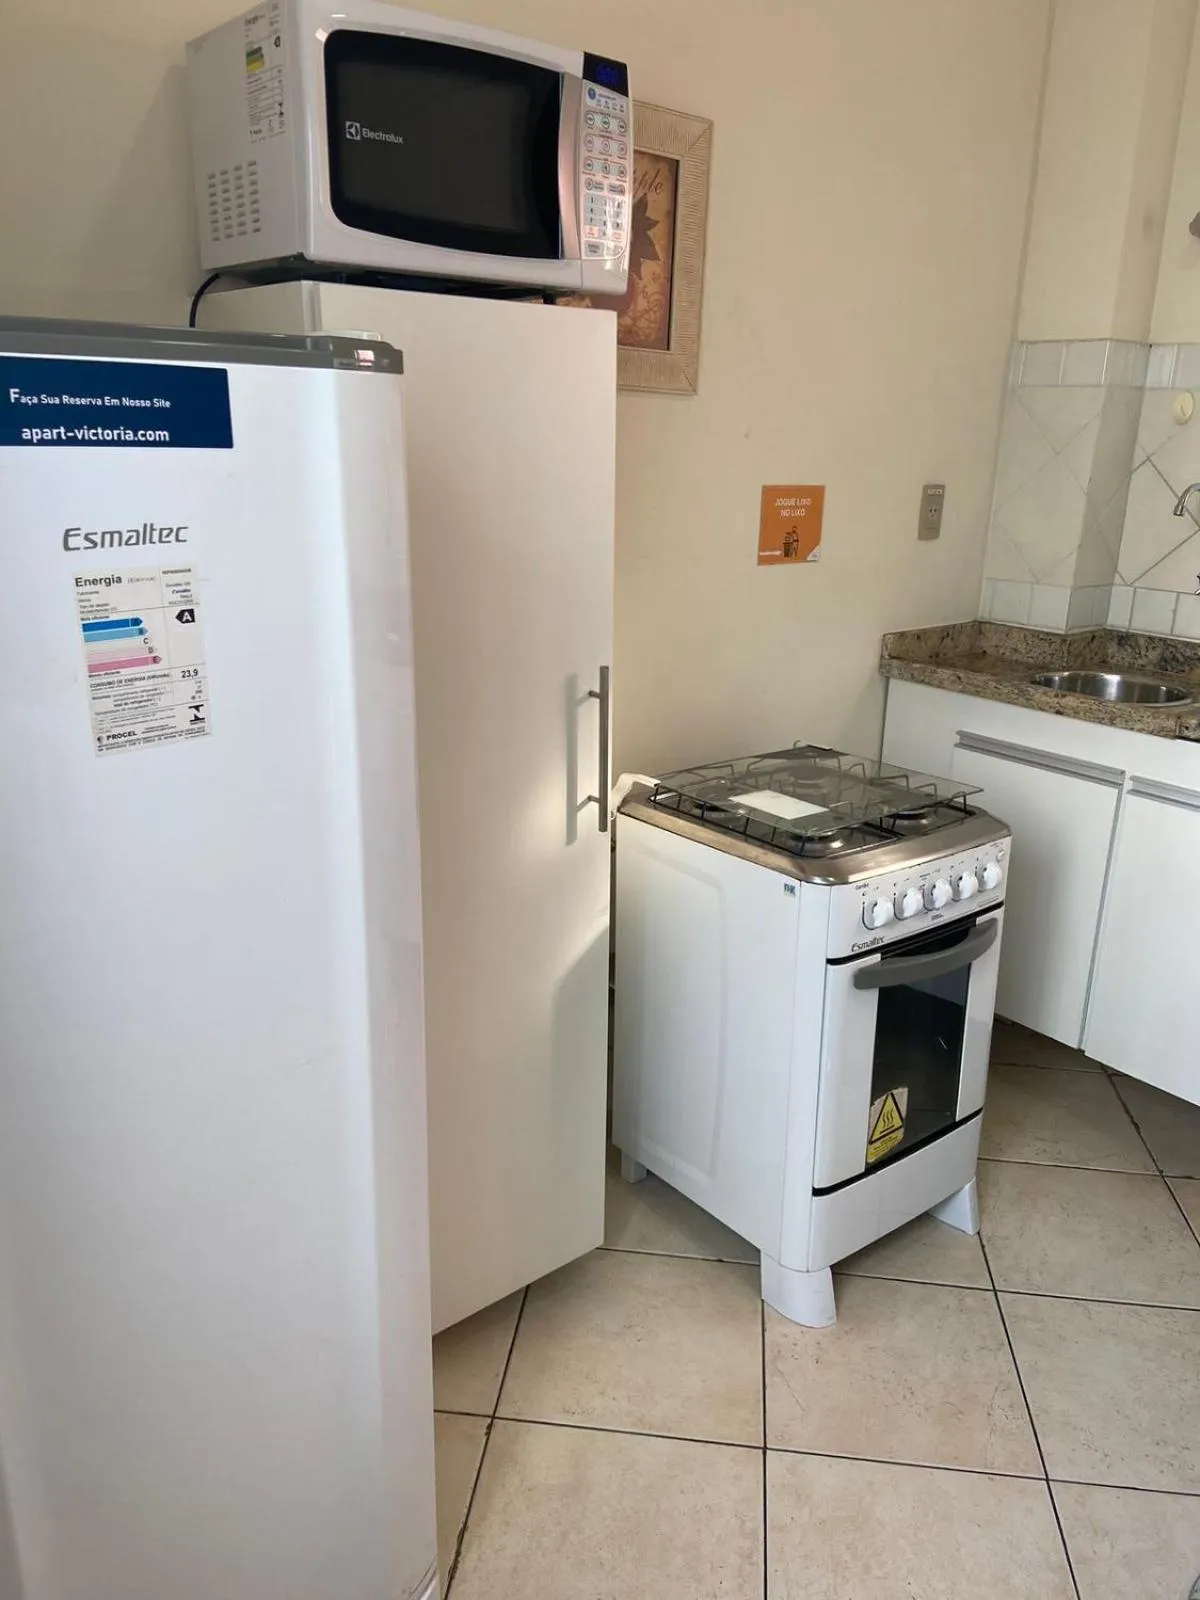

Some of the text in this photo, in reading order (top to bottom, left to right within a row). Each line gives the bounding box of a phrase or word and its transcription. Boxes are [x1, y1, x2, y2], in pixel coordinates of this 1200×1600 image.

[361, 128, 404, 144] Electrolux
[9, 388, 171, 408] Faça Sua Reserva Em Nosso Site
[21, 425, 170, 443] apart-victoria.com
[62, 522, 189, 551] Esmaltec
[74, 574, 123, 588] Energia
[182, 611, 192, 622] A
[180, 668, 199, 679] 23,9
[106, 731, 138, 741] PROCEL
[851, 936, 886, 952] Esmaltec
